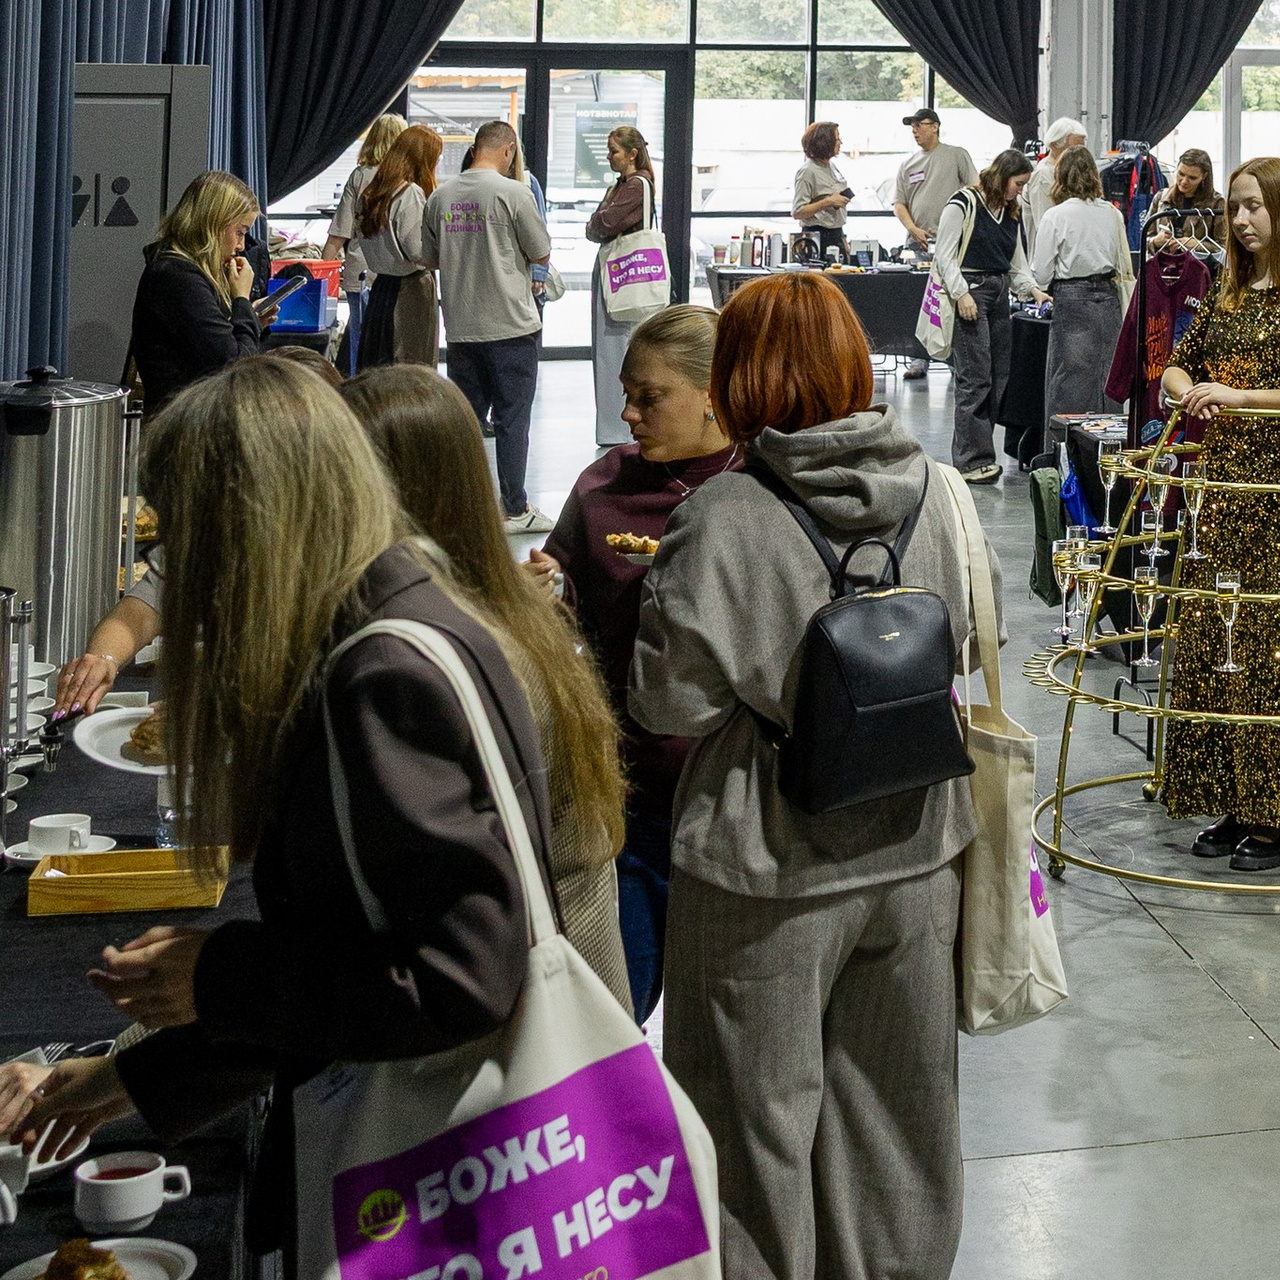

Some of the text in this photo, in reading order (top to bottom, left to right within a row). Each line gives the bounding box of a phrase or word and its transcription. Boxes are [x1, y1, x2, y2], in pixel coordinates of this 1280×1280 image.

[450, 202, 480, 211] БОЕВАЯ
[445, 224, 483, 233] ЕДИНИЦА
[619, 253, 647, 270] БОЖЕ,
[628, 267, 636, 276] Я
[637, 265, 663, 275] НЕСУ
[415, 1114, 586, 1224] БОЖЕ,
[497, 1155, 675, 1280] Я НЕСУ
